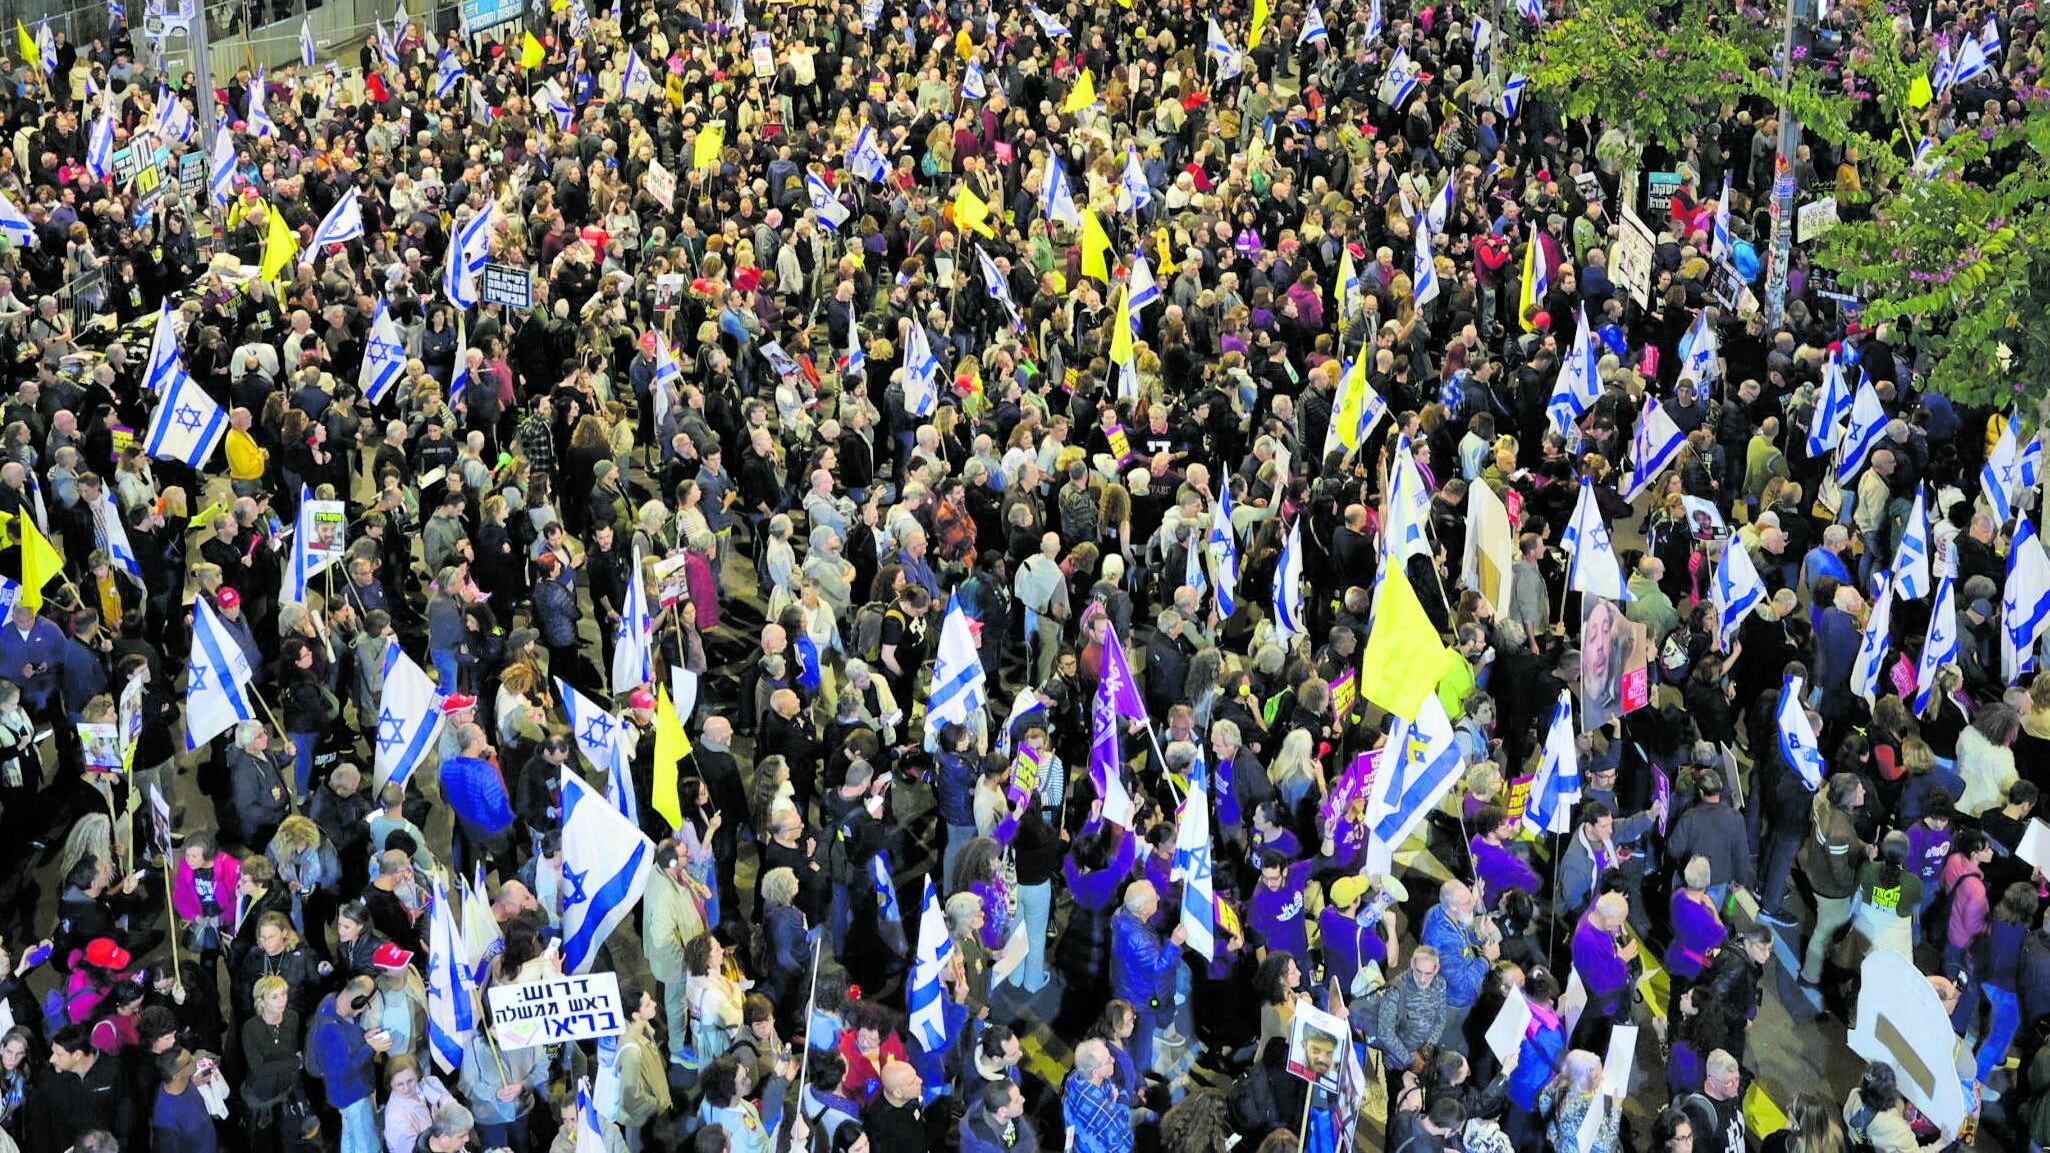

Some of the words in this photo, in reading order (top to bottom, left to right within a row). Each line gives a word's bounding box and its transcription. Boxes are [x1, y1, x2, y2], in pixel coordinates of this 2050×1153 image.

[487, 270, 501, 280] את
[487, 279, 526, 293] המלחמה
[516, 979, 590, 1002] דרוש:
[495, 1002, 560, 1024] ממשלה
[568, 995, 611, 1012] ראש
[544, 1012, 620, 1038] בריא!
